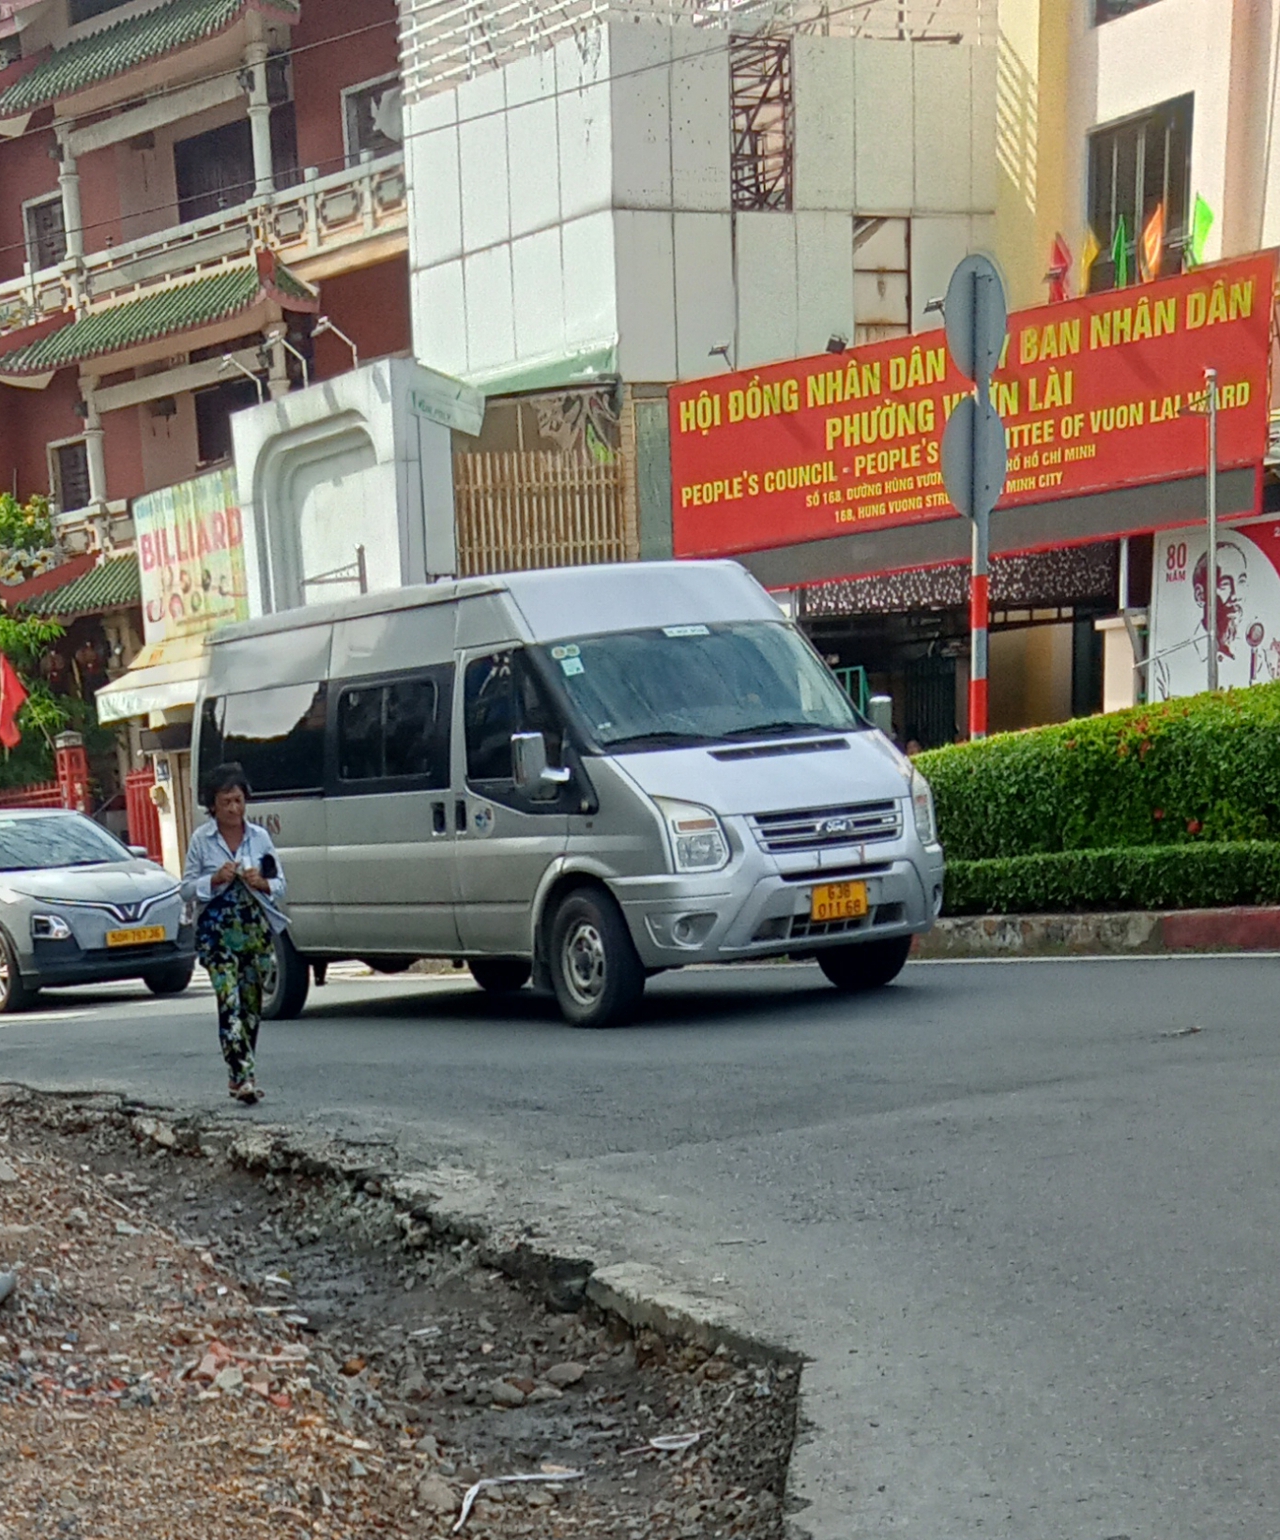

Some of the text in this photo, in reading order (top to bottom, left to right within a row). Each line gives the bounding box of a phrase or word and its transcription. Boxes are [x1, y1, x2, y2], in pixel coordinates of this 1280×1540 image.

[680, 390, 720, 435] HỘI
[728, 375, 799, 423] ĐỒNG
[807, 360, 881, 408] NHÂN
[889, 346, 946, 392] DÂN
[1020, 318, 1081, 365] BAN
[1089, 297, 1177, 351] NHÂN
[1186, 282, 1253, 330] DÂN
[826, 399, 935, 451] PHƯỜNG
[1028, 367, 1073, 412] LÀI
[681, 470, 759, 508] PEOPLE'S
[764, 460, 838, 493] COUNCIL
[854, 438, 939, 477] PEOPLE'S
[1061, 415, 1084, 440] OF
[1090, 402, 1144, 434] VUON
[1150, 394, 1181, 423] LAI
[1064, 444, 1096, 462] MINH
[858, 503, 886, 519] HUNG
[888, 496, 923, 514] VUONG
[1006, 476, 1036, 493] MINH
[1038, 471, 1063, 488] CITY
[140, 506, 244, 572] BILLIARD
[1166, 542, 1187, 570] 80
[826, 819, 848, 833] Ford
